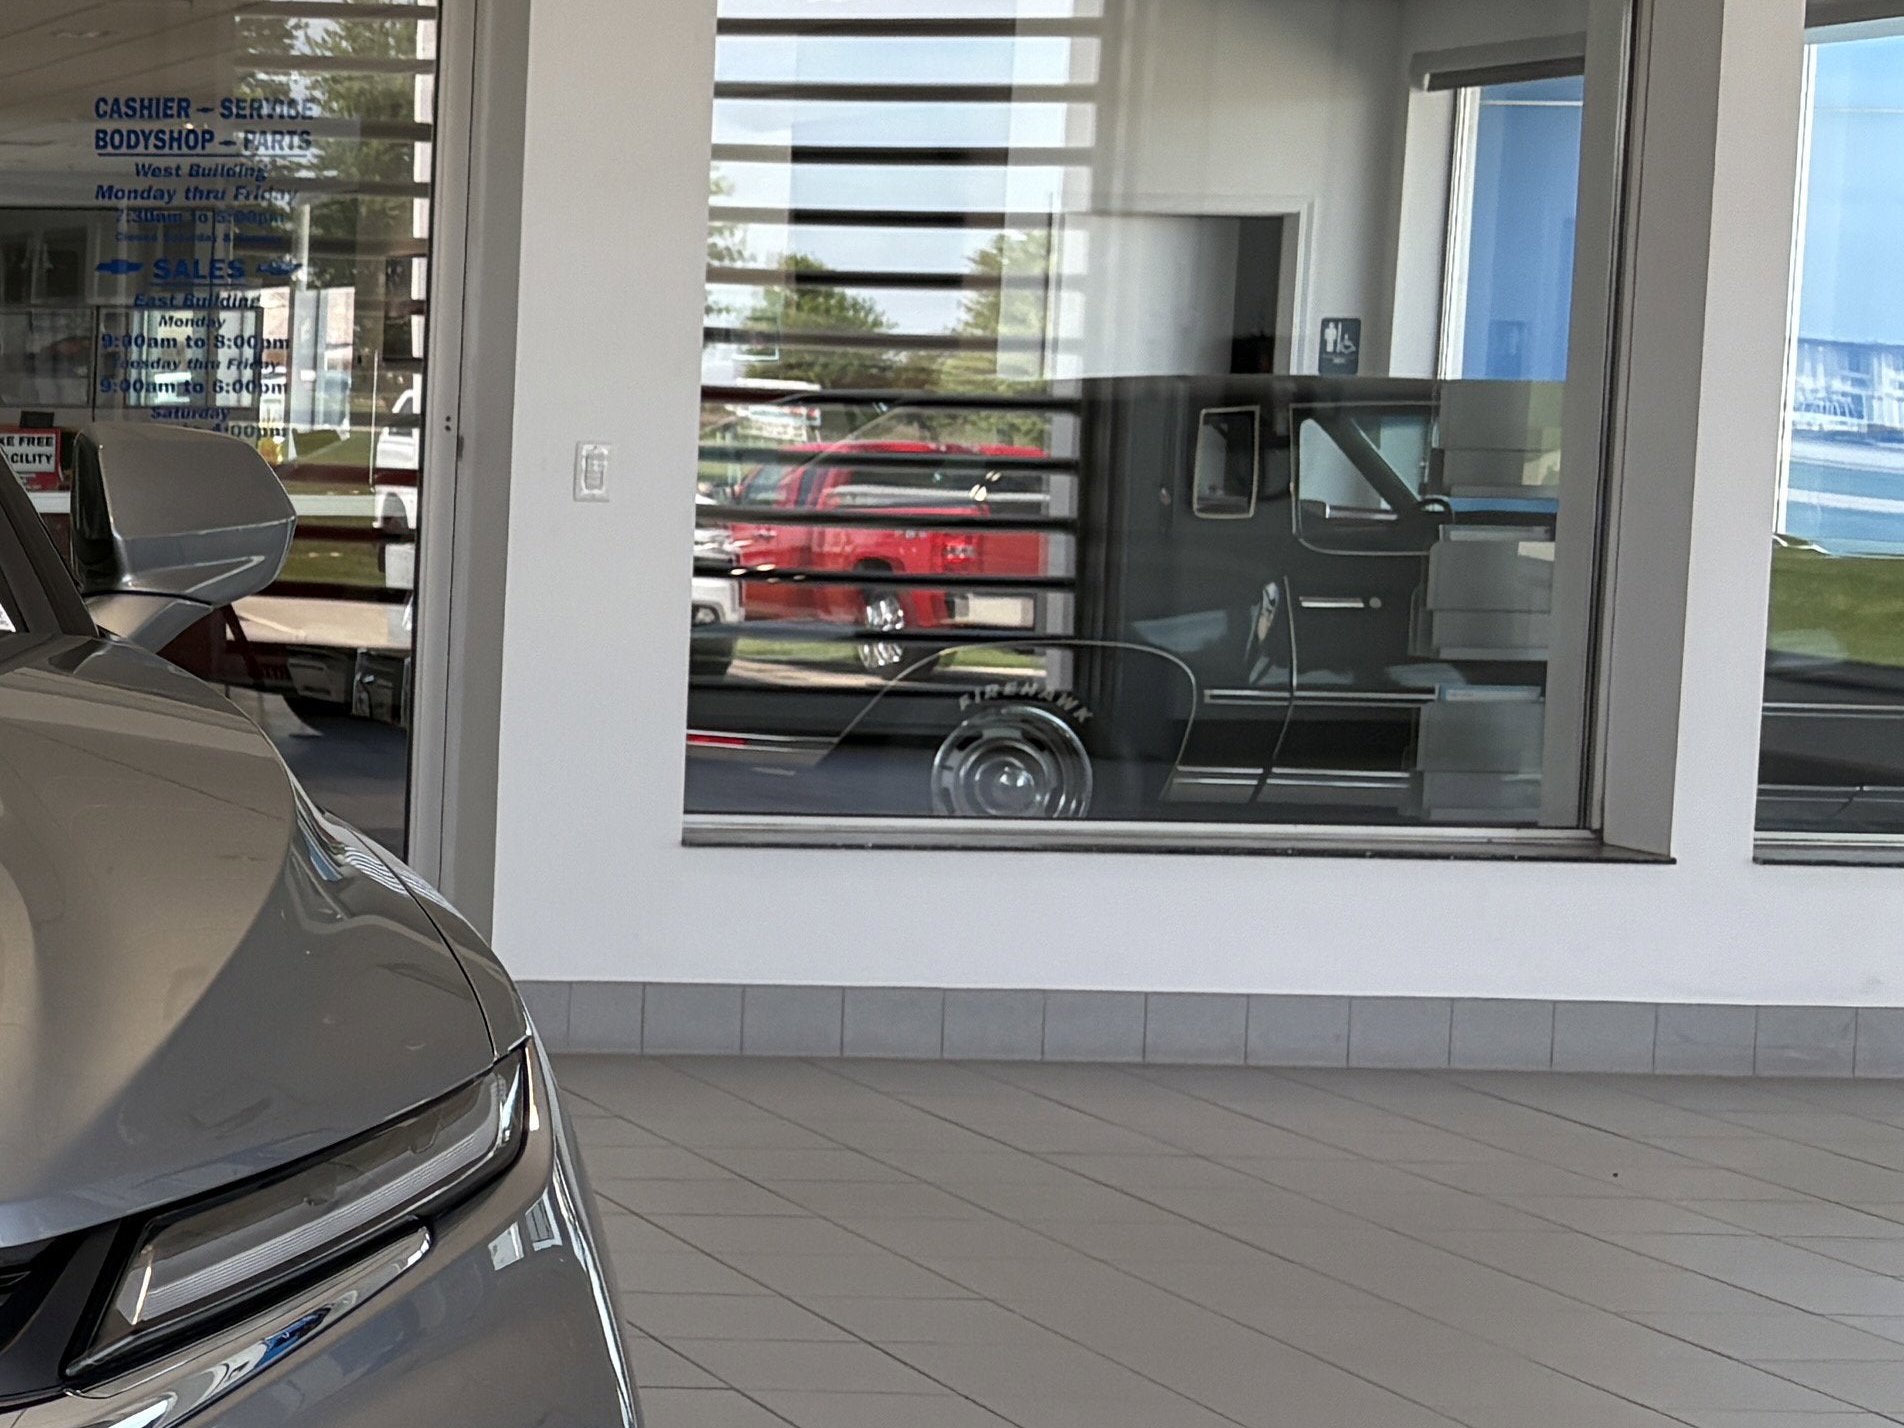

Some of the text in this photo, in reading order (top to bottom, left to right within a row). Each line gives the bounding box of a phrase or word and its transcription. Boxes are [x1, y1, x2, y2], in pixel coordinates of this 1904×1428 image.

[94, 97, 315, 121] CASHIER SERVICE
[94, 129, 312, 152] BODYSHOP PARTS
[135, 163, 269, 182] West Building
[95, 185, 298, 206] Monday thru Friday
[153, 258, 245, 281] SALES
[134, 292, 261, 311] East Building
[158, 315, 226, 330] Monday
[101, 334, 290, 352] 9:00am to 8:00pm
[187, 357, 221, 371] thru
[227, 357, 279, 373] Friday
[100, 379, 178, 394] 9:00am
[184, 379, 205, 394] to
[151, 406, 230, 422] Saturday
[18, 436, 54, 447] FREE
[7, 453, 53, 465] CILITY
[959, 681, 1094, 723] FIREHAWK
